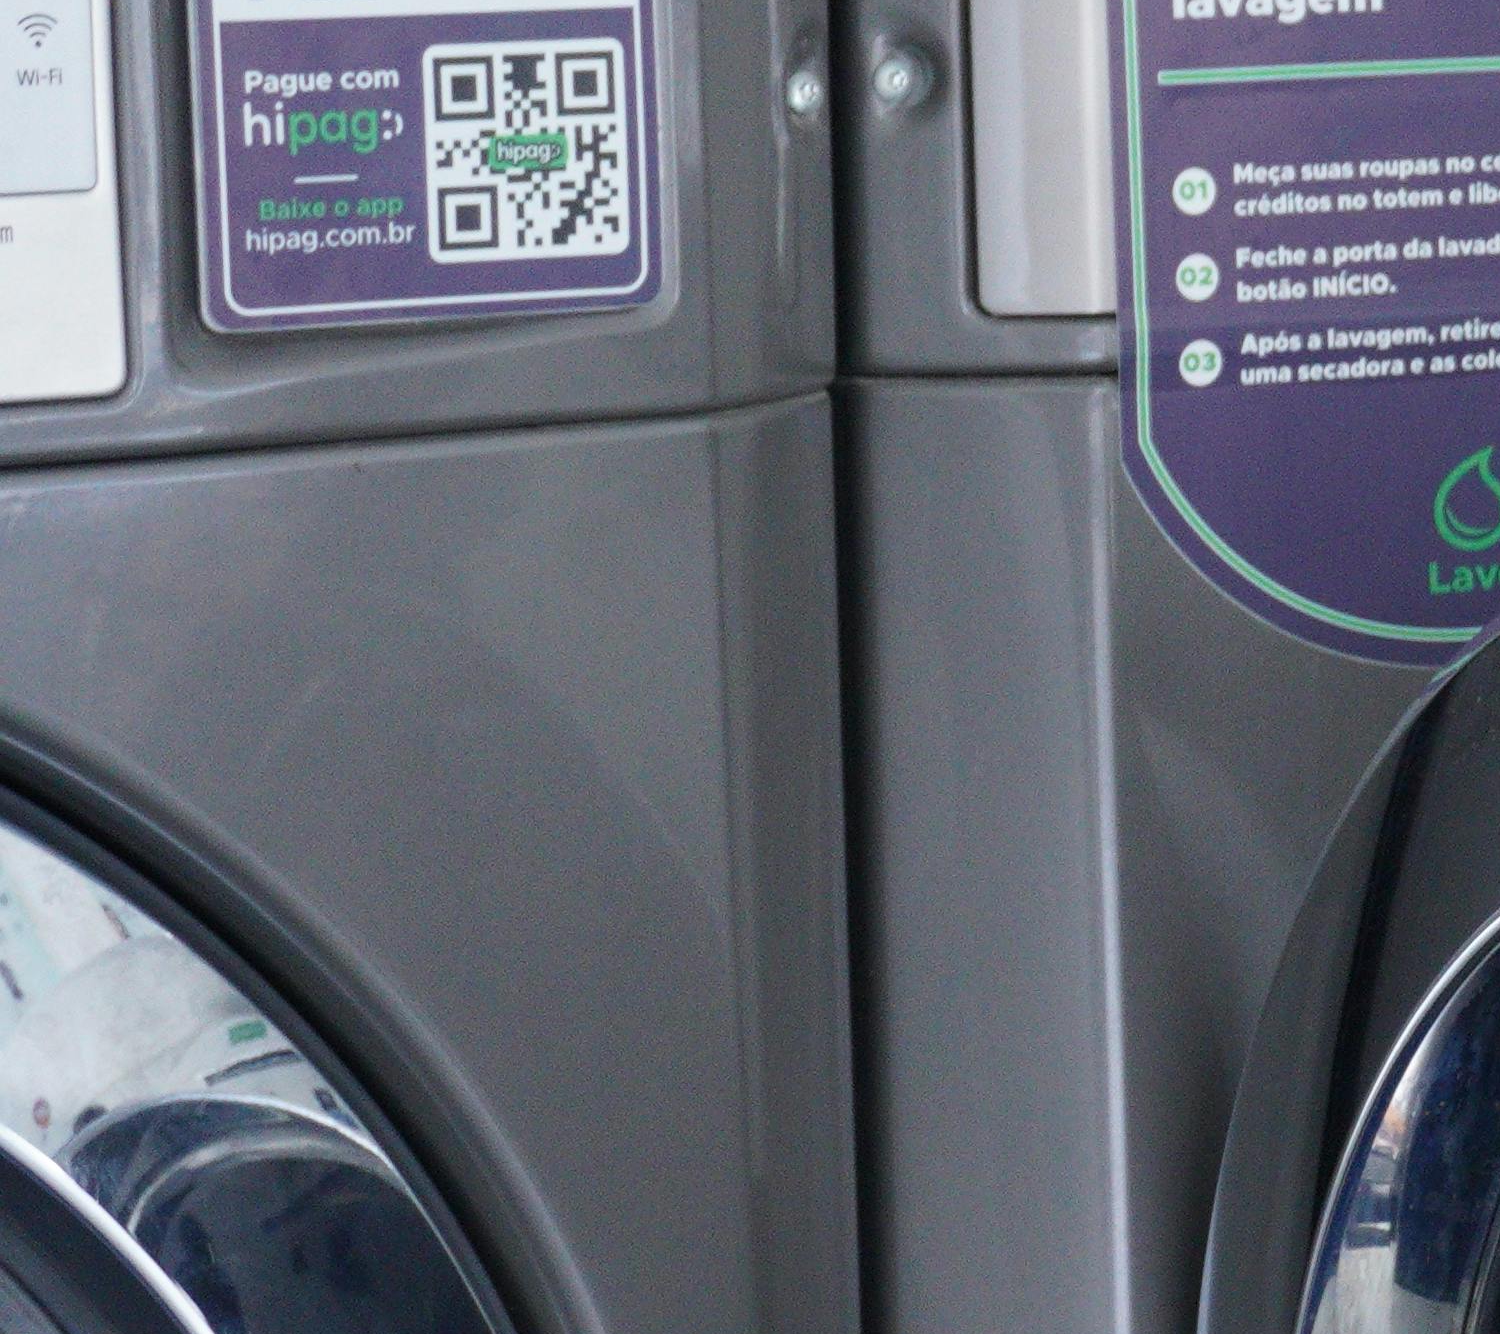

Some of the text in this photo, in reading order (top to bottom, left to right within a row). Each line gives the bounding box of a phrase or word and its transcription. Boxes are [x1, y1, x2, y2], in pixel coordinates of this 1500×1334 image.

[17, 67, 63, 86] Wi-Fi
[244, 69, 400, 98] Pague com
[1233, 162, 1296, 186] Meça
[1300, 161, 1354, 181] suas
[1359, 158, 1440, 180] roupas
[1445, 156, 1475, 173] no
[1180, 181, 1207, 200] 01
[1234, 191, 1332, 217] créditos
[1337, 193, 1368, 211] no
[1372, 188, 1444, 209] totem
[1449, 188, 1463, 205] e
[259, 197, 403, 220] Baixe o app
[245, 221, 415, 255] hipag.com.br
[1235, 245, 1307, 269] Feche
[1313, 247, 1327, 264] a
[1333, 241, 1398, 267] porta
[1403, 238, 1433, 259] da
[1180, 266, 1212, 286] 02
[1236, 278, 1307, 302] botão
[1241, 330, 1302, 358] Após
[1307, 333, 1322, 350] a
[1180, 352, 1216, 372] 03
[1240, 365, 1292, 385] uma
[1298, 357, 1405, 382] secadora
[1410, 357, 1425, 374] e
[1430, 355, 1456, 373] as
